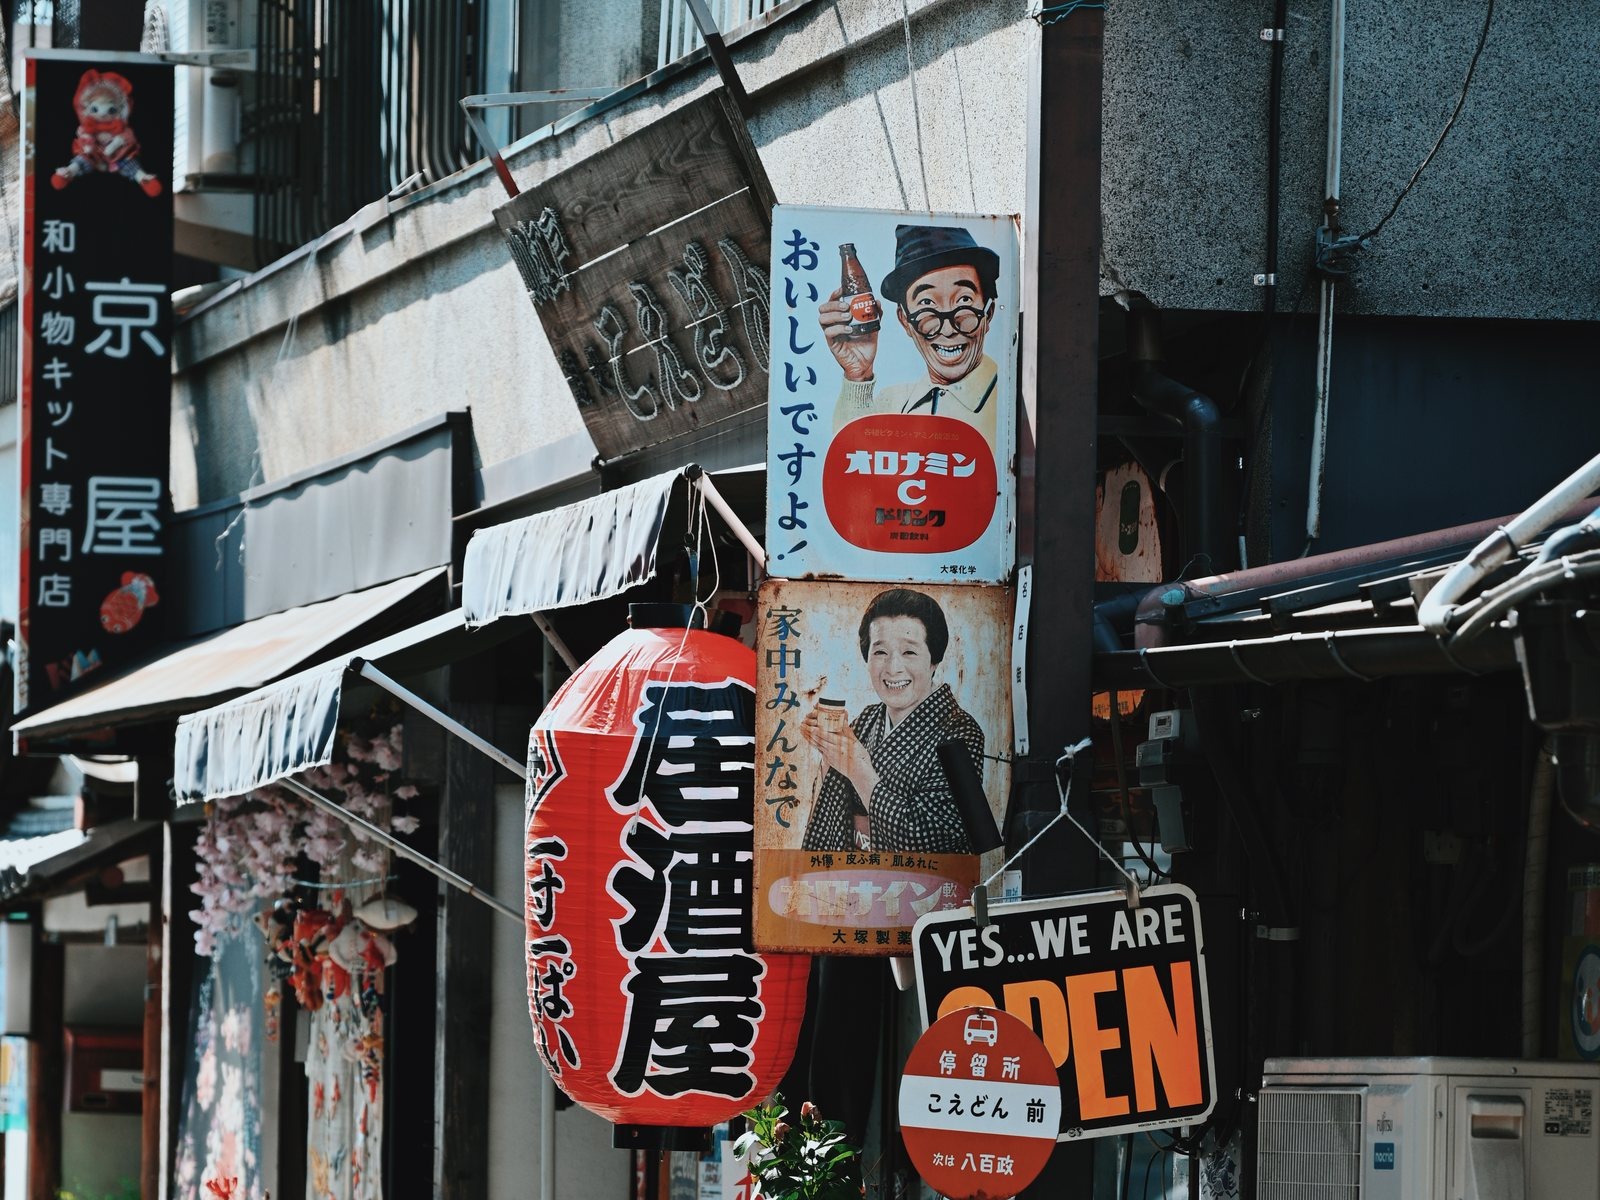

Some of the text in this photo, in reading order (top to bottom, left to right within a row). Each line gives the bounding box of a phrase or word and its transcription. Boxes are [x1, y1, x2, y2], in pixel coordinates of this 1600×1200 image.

[37, 218, 76, 608] 和小物キット専門店
[81, 277, 167, 557] 京屋
[844, 450, 977, 478] オロナミン
[896, 478, 927, 506] C
[875, 508, 946, 527] ドリンク
[940, 564, 977, 575] 大塚化学
[764, 605, 803, 829] 家中みんなで
[810, 854, 939, 870] 外傷・皮ふ病・肌あれに
[606, 678, 768, 1100] 居酒屋
[780, 880, 943, 917] オロナイン
[832, 929, 912, 945] 大塚製薬
[1110, 903, 1186, 951] ARE
[936, 960, 1203, 1121] PEN
[938, 1050, 1020, 1080] 停留所
